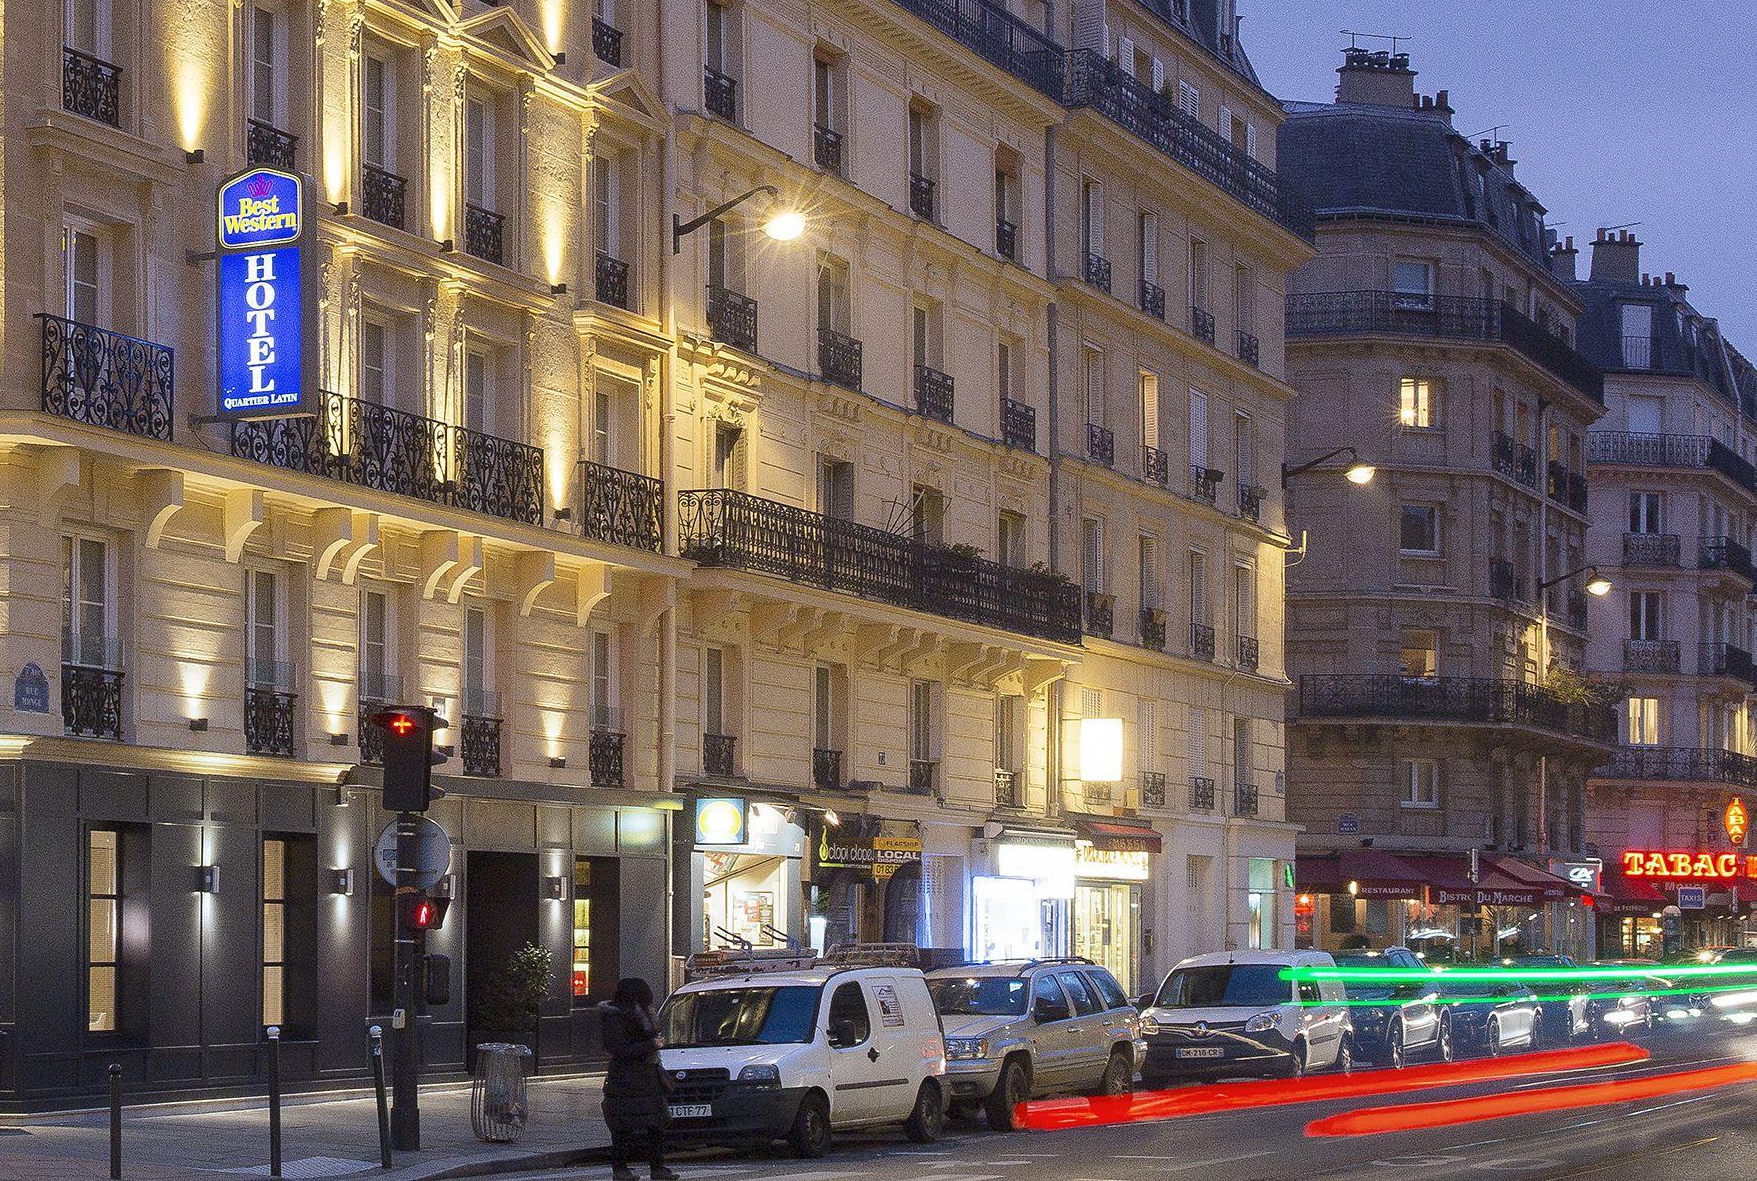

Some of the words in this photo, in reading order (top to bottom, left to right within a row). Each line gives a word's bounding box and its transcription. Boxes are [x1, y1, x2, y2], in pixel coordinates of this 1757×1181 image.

[239, 195, 280, 217] Best
[224, 212, 297, 235] Western
[244, 253, 277, 394] HOTEL
[224, 395, 269, 409] QUARTIER
[270, 392, 298, 404] LATIN
[1728, 797, 1745, 844] TABAC
[877, 850, 920, 860] LOCAL
[1623, 852, 1738, 877] TABAC
[1361, 887, 1415, 895] RESTAURANT
[1680, 894, 1702, 902] TAXIS
